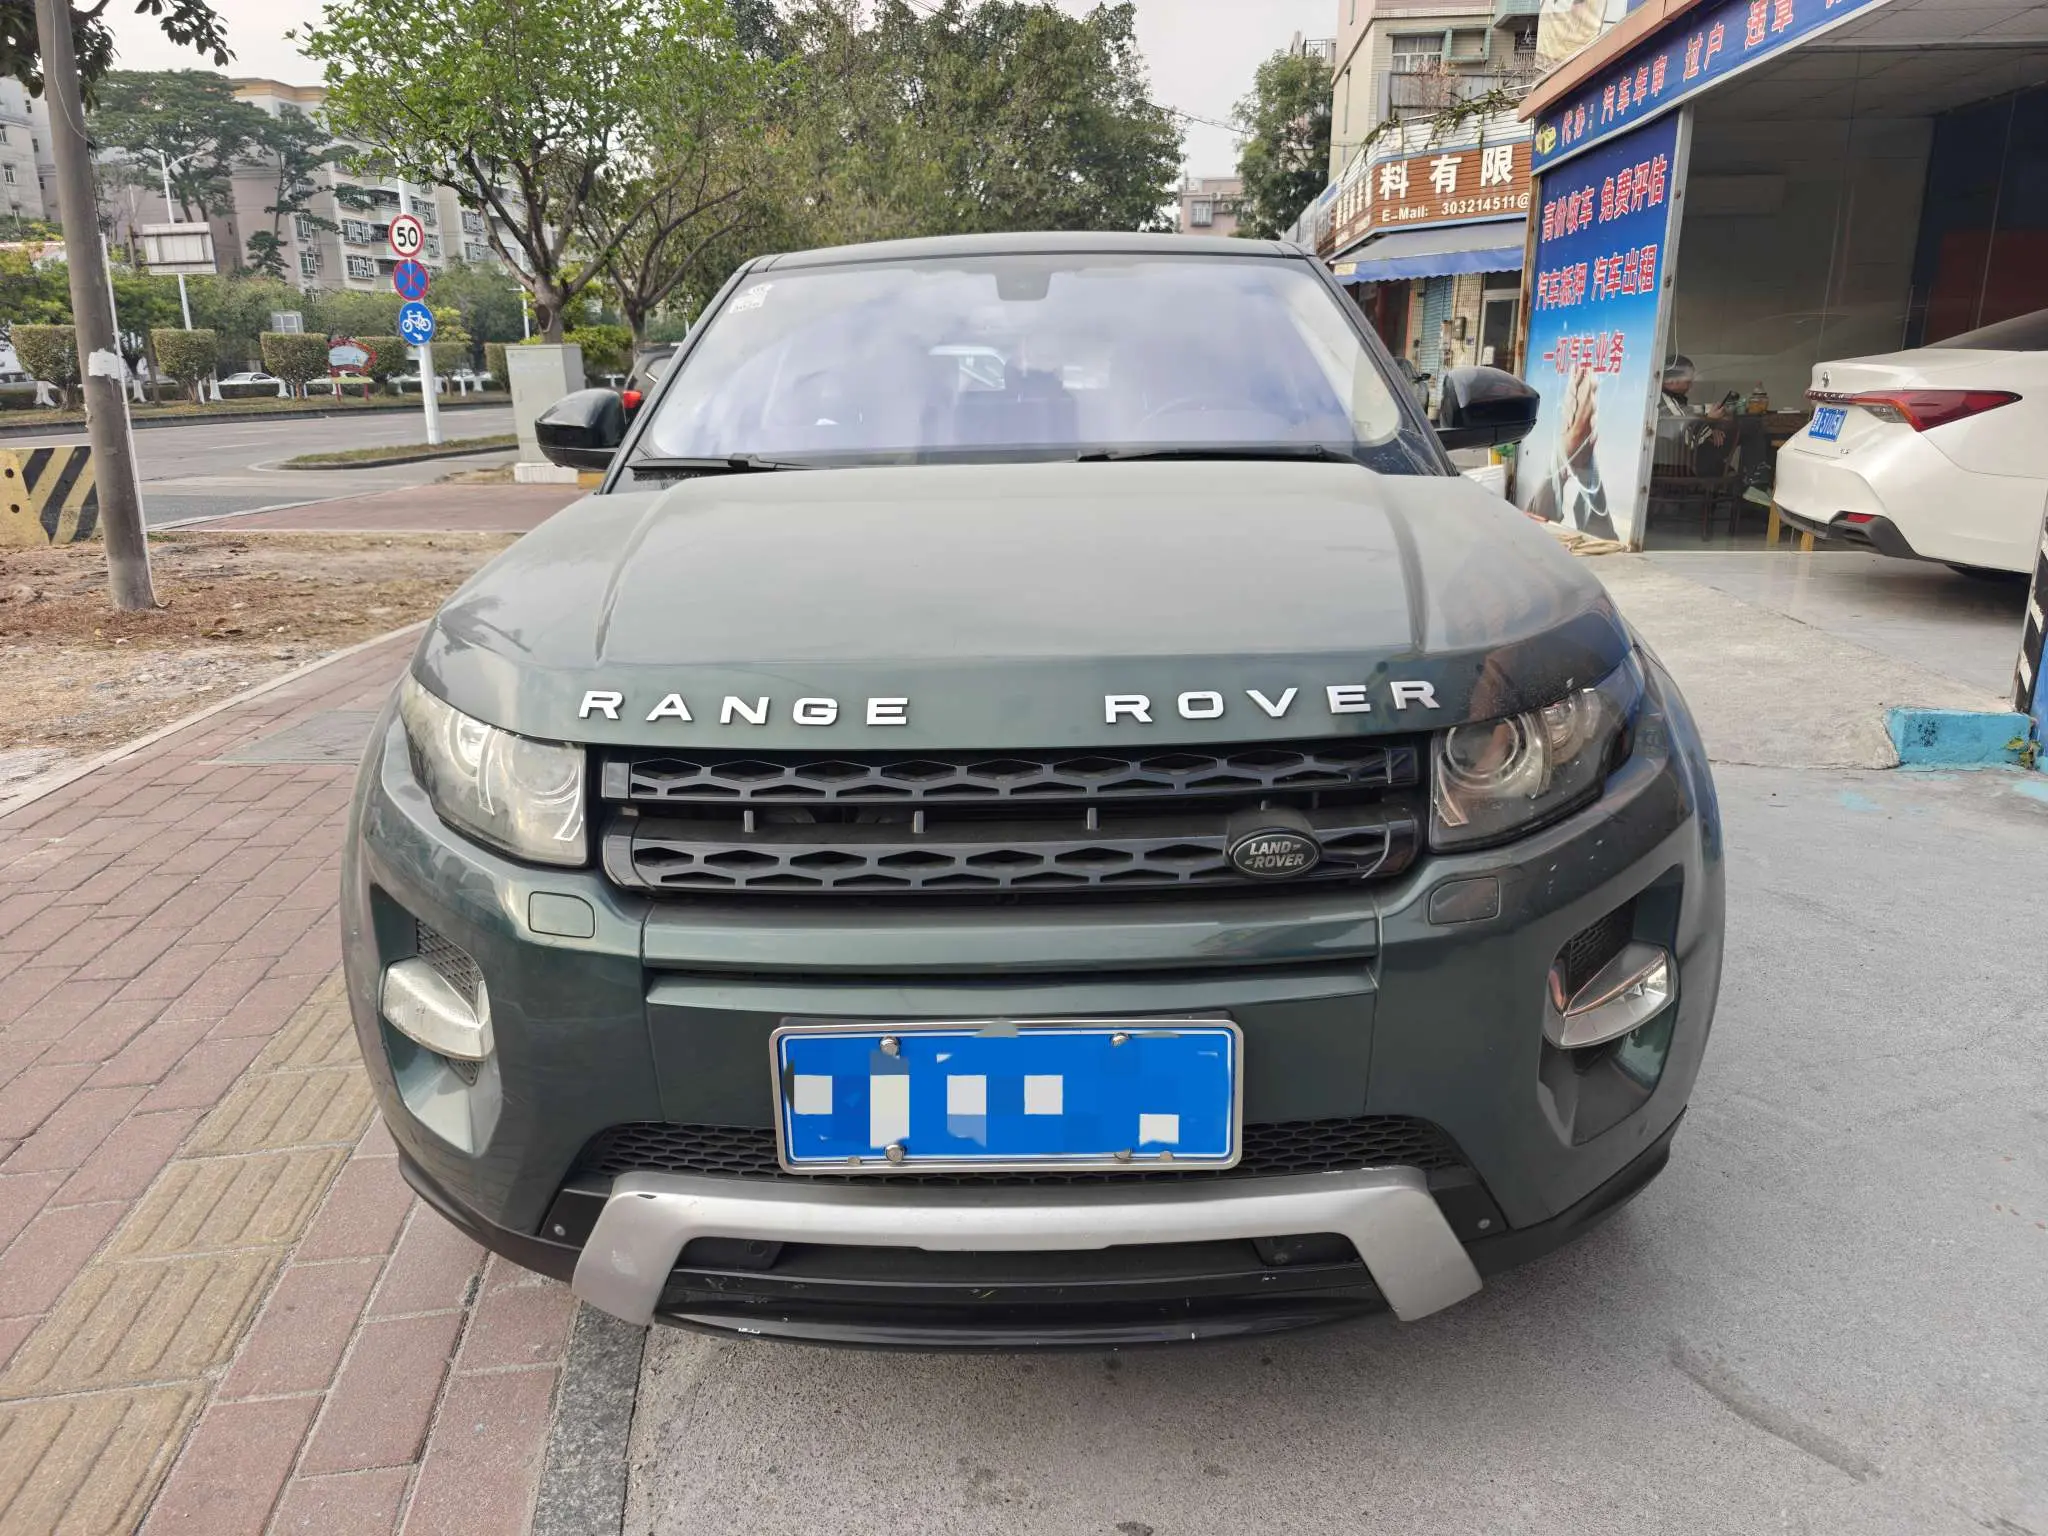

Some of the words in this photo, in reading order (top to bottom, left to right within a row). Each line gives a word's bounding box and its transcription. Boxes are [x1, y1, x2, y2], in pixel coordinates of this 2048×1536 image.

[1683, 21, 1725, 83] 过户
[1379, 144, 1513, 200] 料有限
[1541, 185, 1594, 243] 高价收车
[1598, 153, 1668, 224] 免费评估
[397, 226, 418, 248] 50
[1535, 262, 1588, 311] 汽车抵押
[1591, 244, 1657, 301] 汽车出租
[1543, 329, 1625, 376] 一切汽车业务
[578, 690, 909, 725] RANGE
[1105, 680, 1441, 724] ROVER
